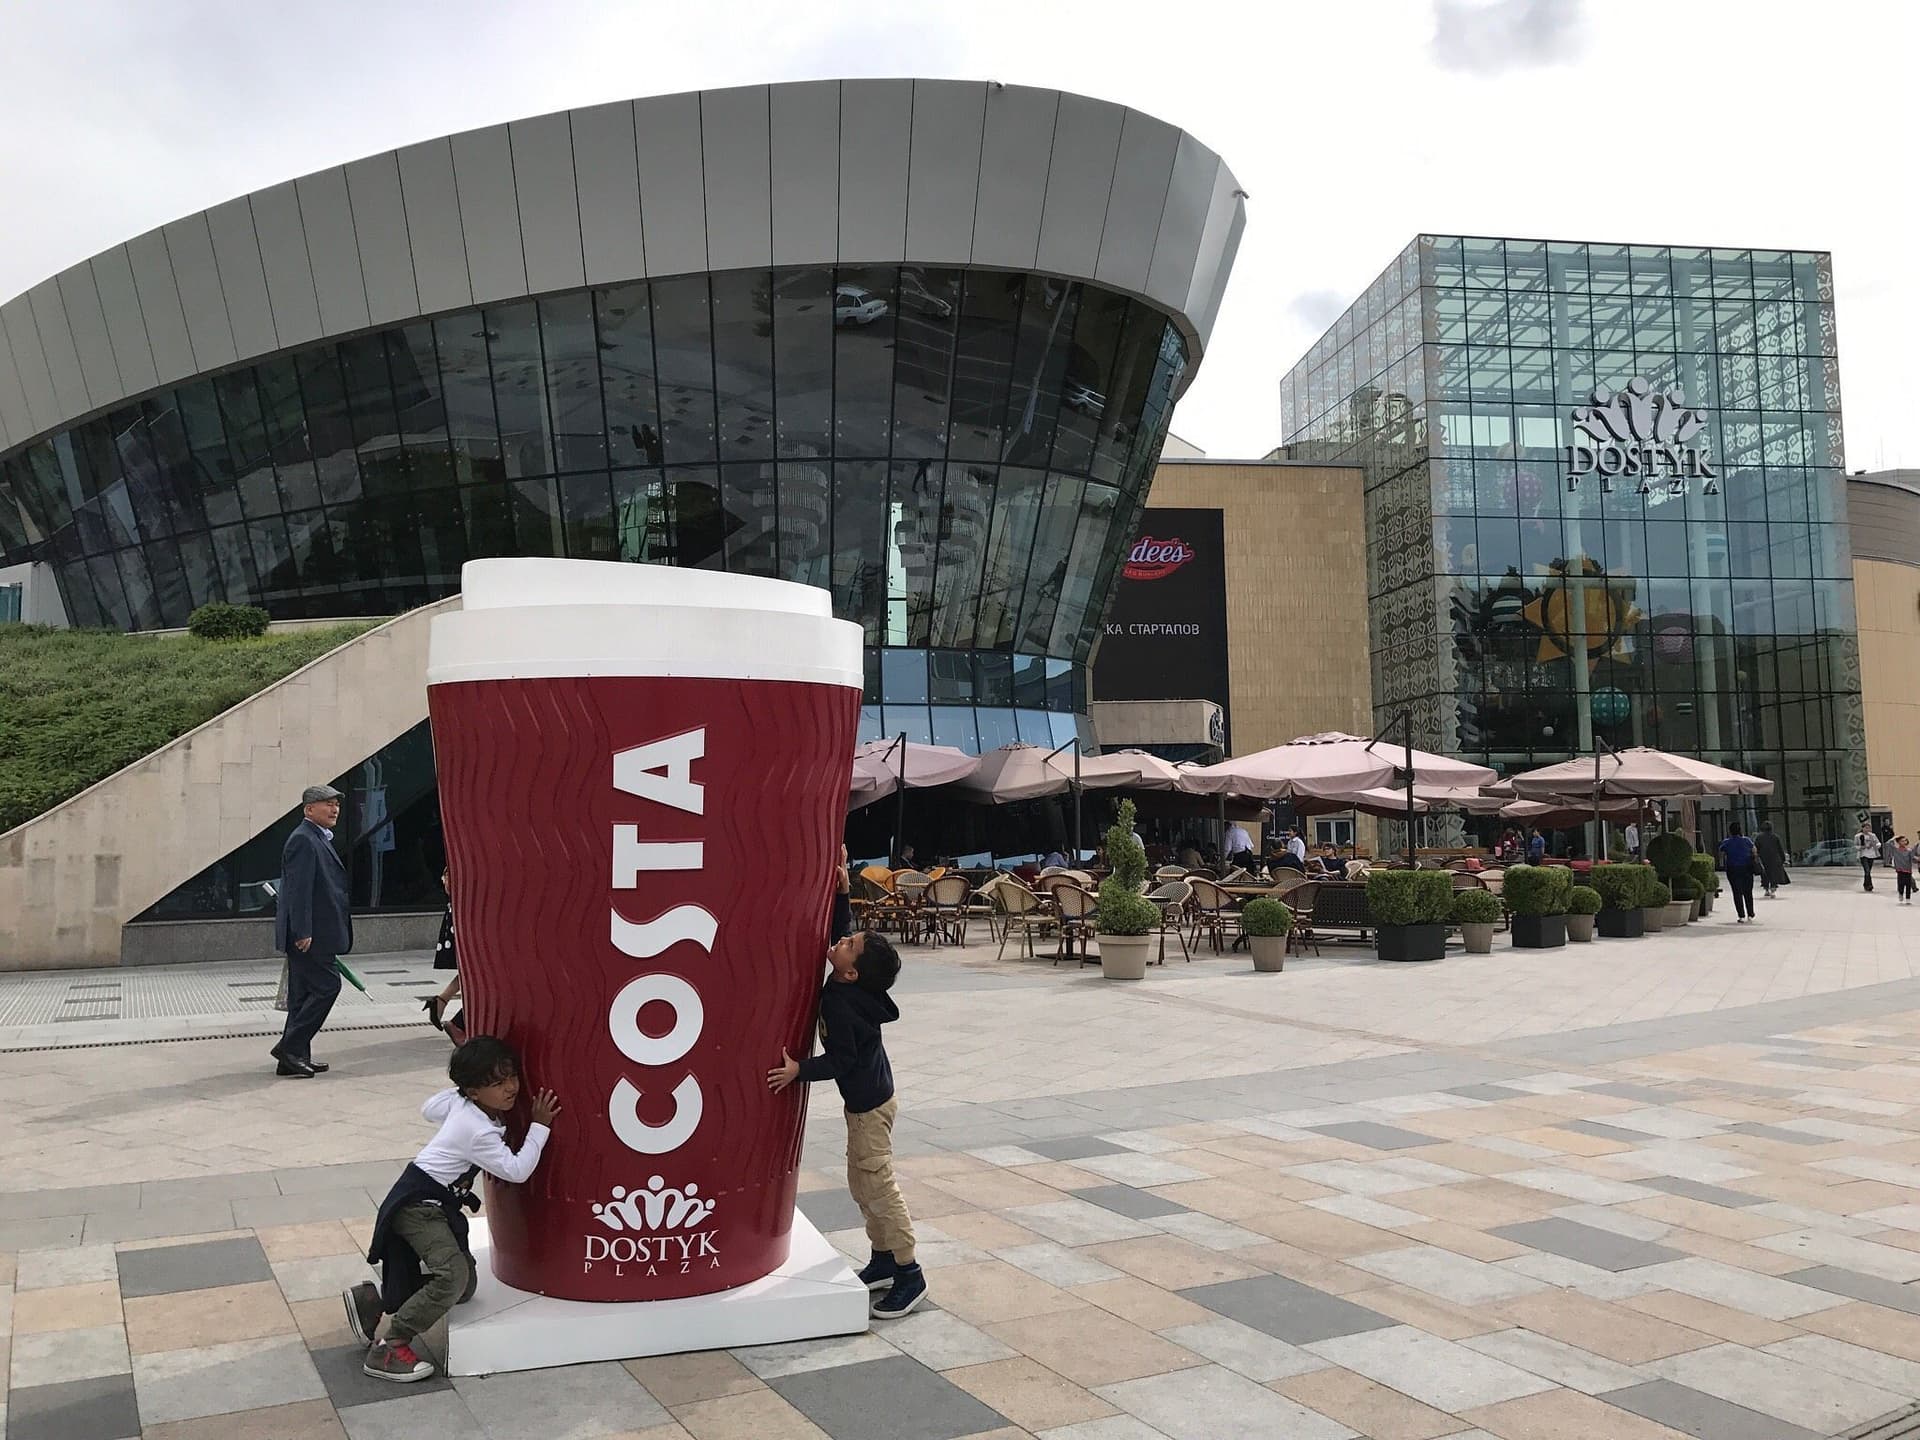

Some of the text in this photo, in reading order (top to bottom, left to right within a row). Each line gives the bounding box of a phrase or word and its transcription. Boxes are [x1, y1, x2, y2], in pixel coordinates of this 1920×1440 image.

[1566, 445, 1718, 478] DOSTYK
[1567, 476, 1720, 495] PLAZA
[1103, 623, 1200, 635] КА СТАРТАПОВ
[608, 727, 719, 1155] COSTA
[584, 1230, 720, 1262] DOSTYK
[584, 1256, 721, 1276] PLAZA
